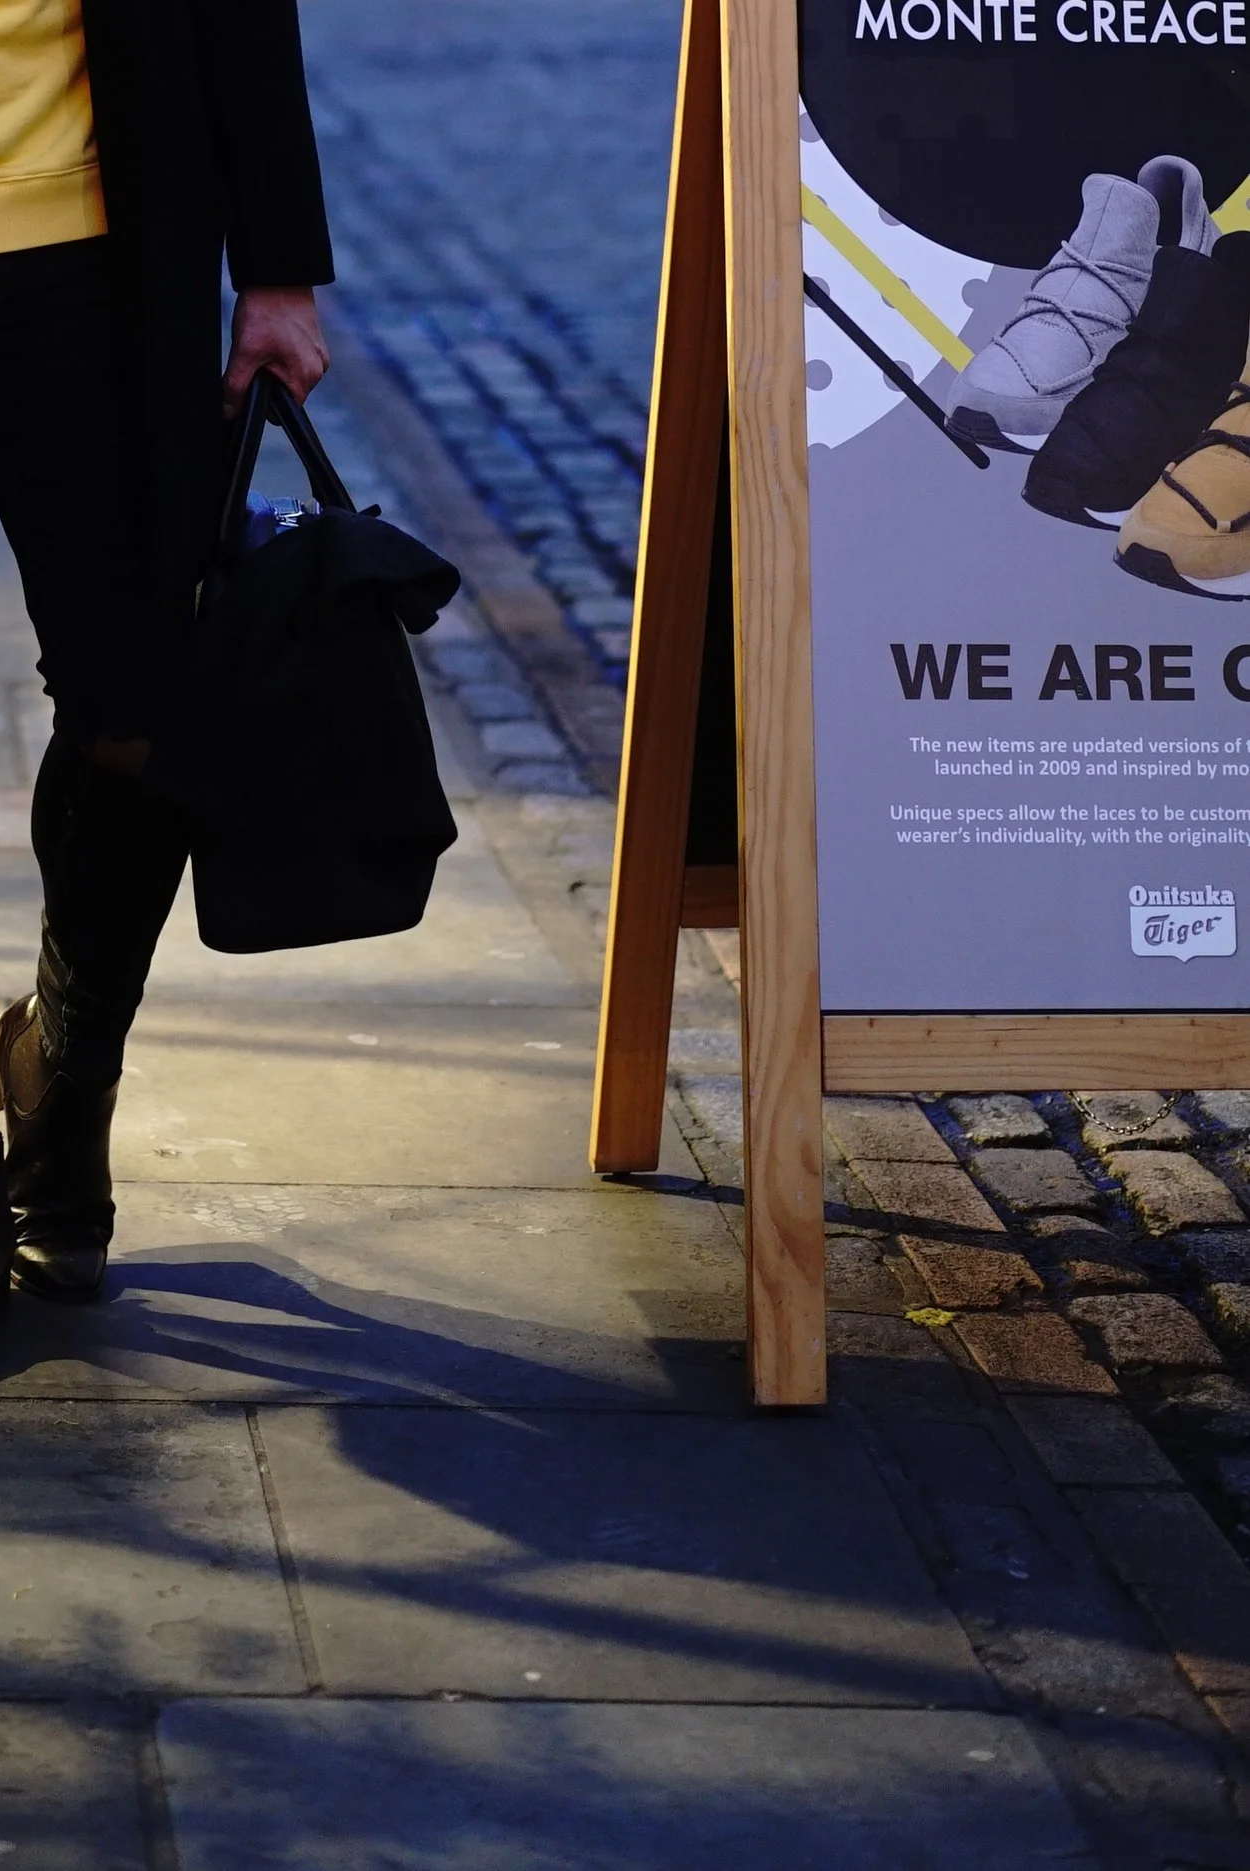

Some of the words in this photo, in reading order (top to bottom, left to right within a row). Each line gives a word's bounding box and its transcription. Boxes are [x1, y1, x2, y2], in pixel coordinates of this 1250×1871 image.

[1056, 0, 1247, 45] CREACE
[889, 643, 1013, 701] WE
[1038, 644, 1196, 702] ARE
[909, 736, 941, 753] The
[946, 740, 983, 753] new
[987, 736, 1035, 753] items
[1039, 741, 1068, 753] are
[1072, 736, 1144, 757] updated
[1148, 737, 1220, 754] versions
[1224, 737, 1244, 754] of
[934, 758, 1013, 776] launched
[1018, 759, 1034, 776] in
[1039, 759, 1081, 776] 2009
[1085, 759, 1118, 776] and
[1122, 759, 1192, 780] inspired
[1197, 759, 1218, 780] by
[890, 804, 952, 824] Unique
[957, 808, 1004, 824] specs
[1008, 804, 1056, 821] allow
[1059, 804, 1089, 821] the
[1093, 804, 1136, 821] laces
[1140, 807, 1159, 821] to
[1164, 804, 1185, 821] be
[896, 826, 971, 843] wearer’s
[975, 826, 1087, 847] individuality,
[1091, 827, 1130, 844] with
[1134, 827, 1163, 844] the
[1129, 884, 1236, 907] Onitsuka
[1144, 914, 1223, 946] Tiger
